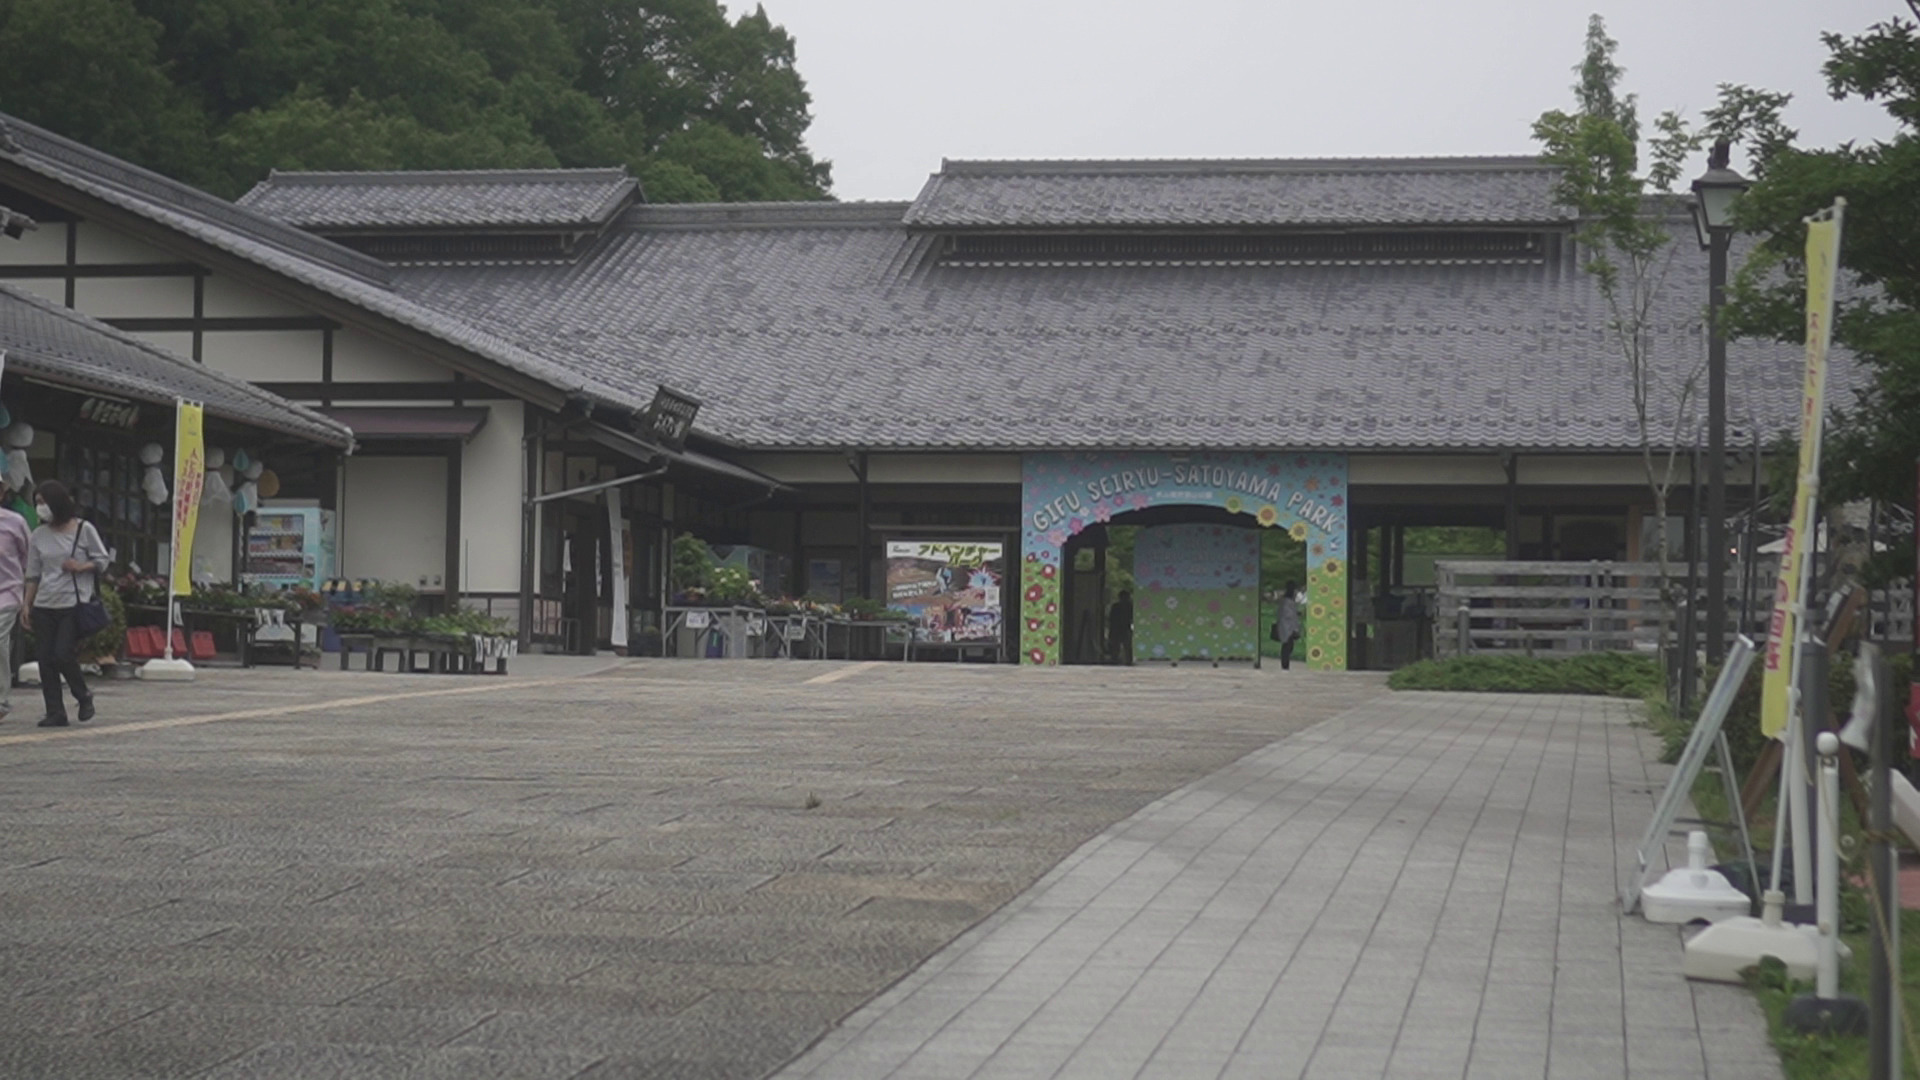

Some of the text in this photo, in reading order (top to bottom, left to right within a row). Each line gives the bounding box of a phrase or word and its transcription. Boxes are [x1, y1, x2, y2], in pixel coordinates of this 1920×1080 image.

[1033, 465, 1338, 532] GIFU SEIRYU-SATOYAMA PARK
